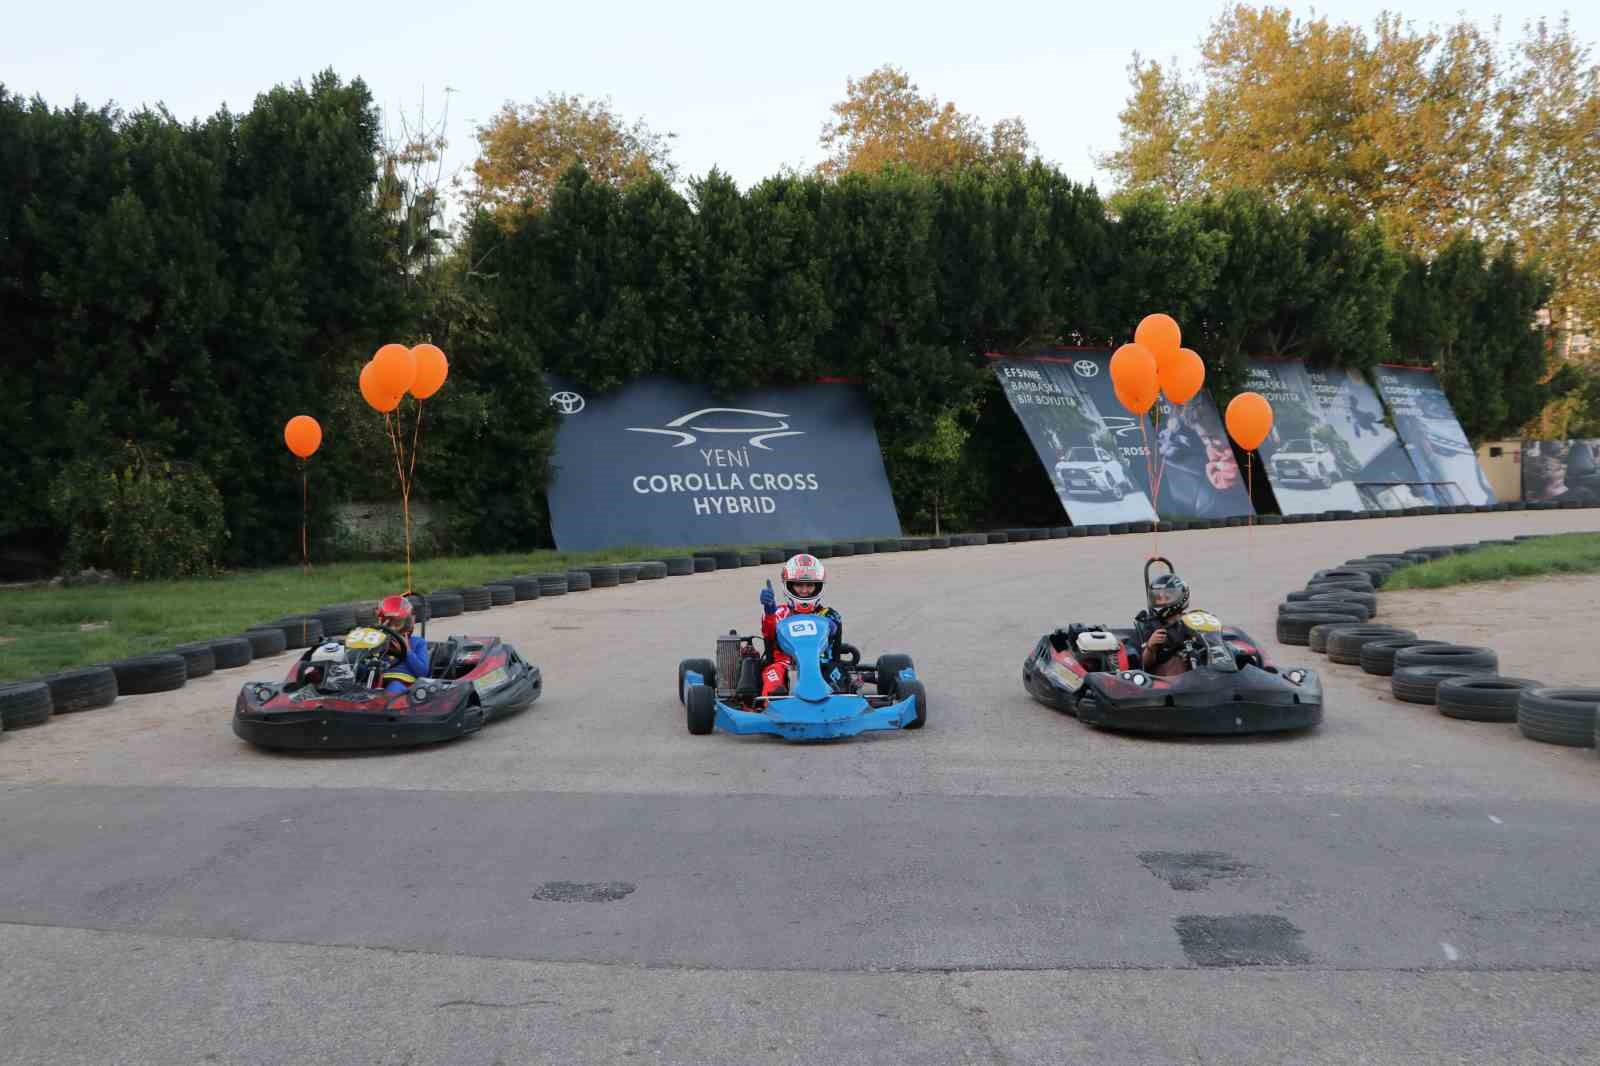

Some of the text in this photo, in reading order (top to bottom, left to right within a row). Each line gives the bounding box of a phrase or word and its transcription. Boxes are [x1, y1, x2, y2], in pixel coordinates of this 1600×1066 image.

[700, 446, 750, 467] YENİ
[633, 473, 819, 493] COROLLA CROSS
[693, 496, 776, 515] HYBRID
